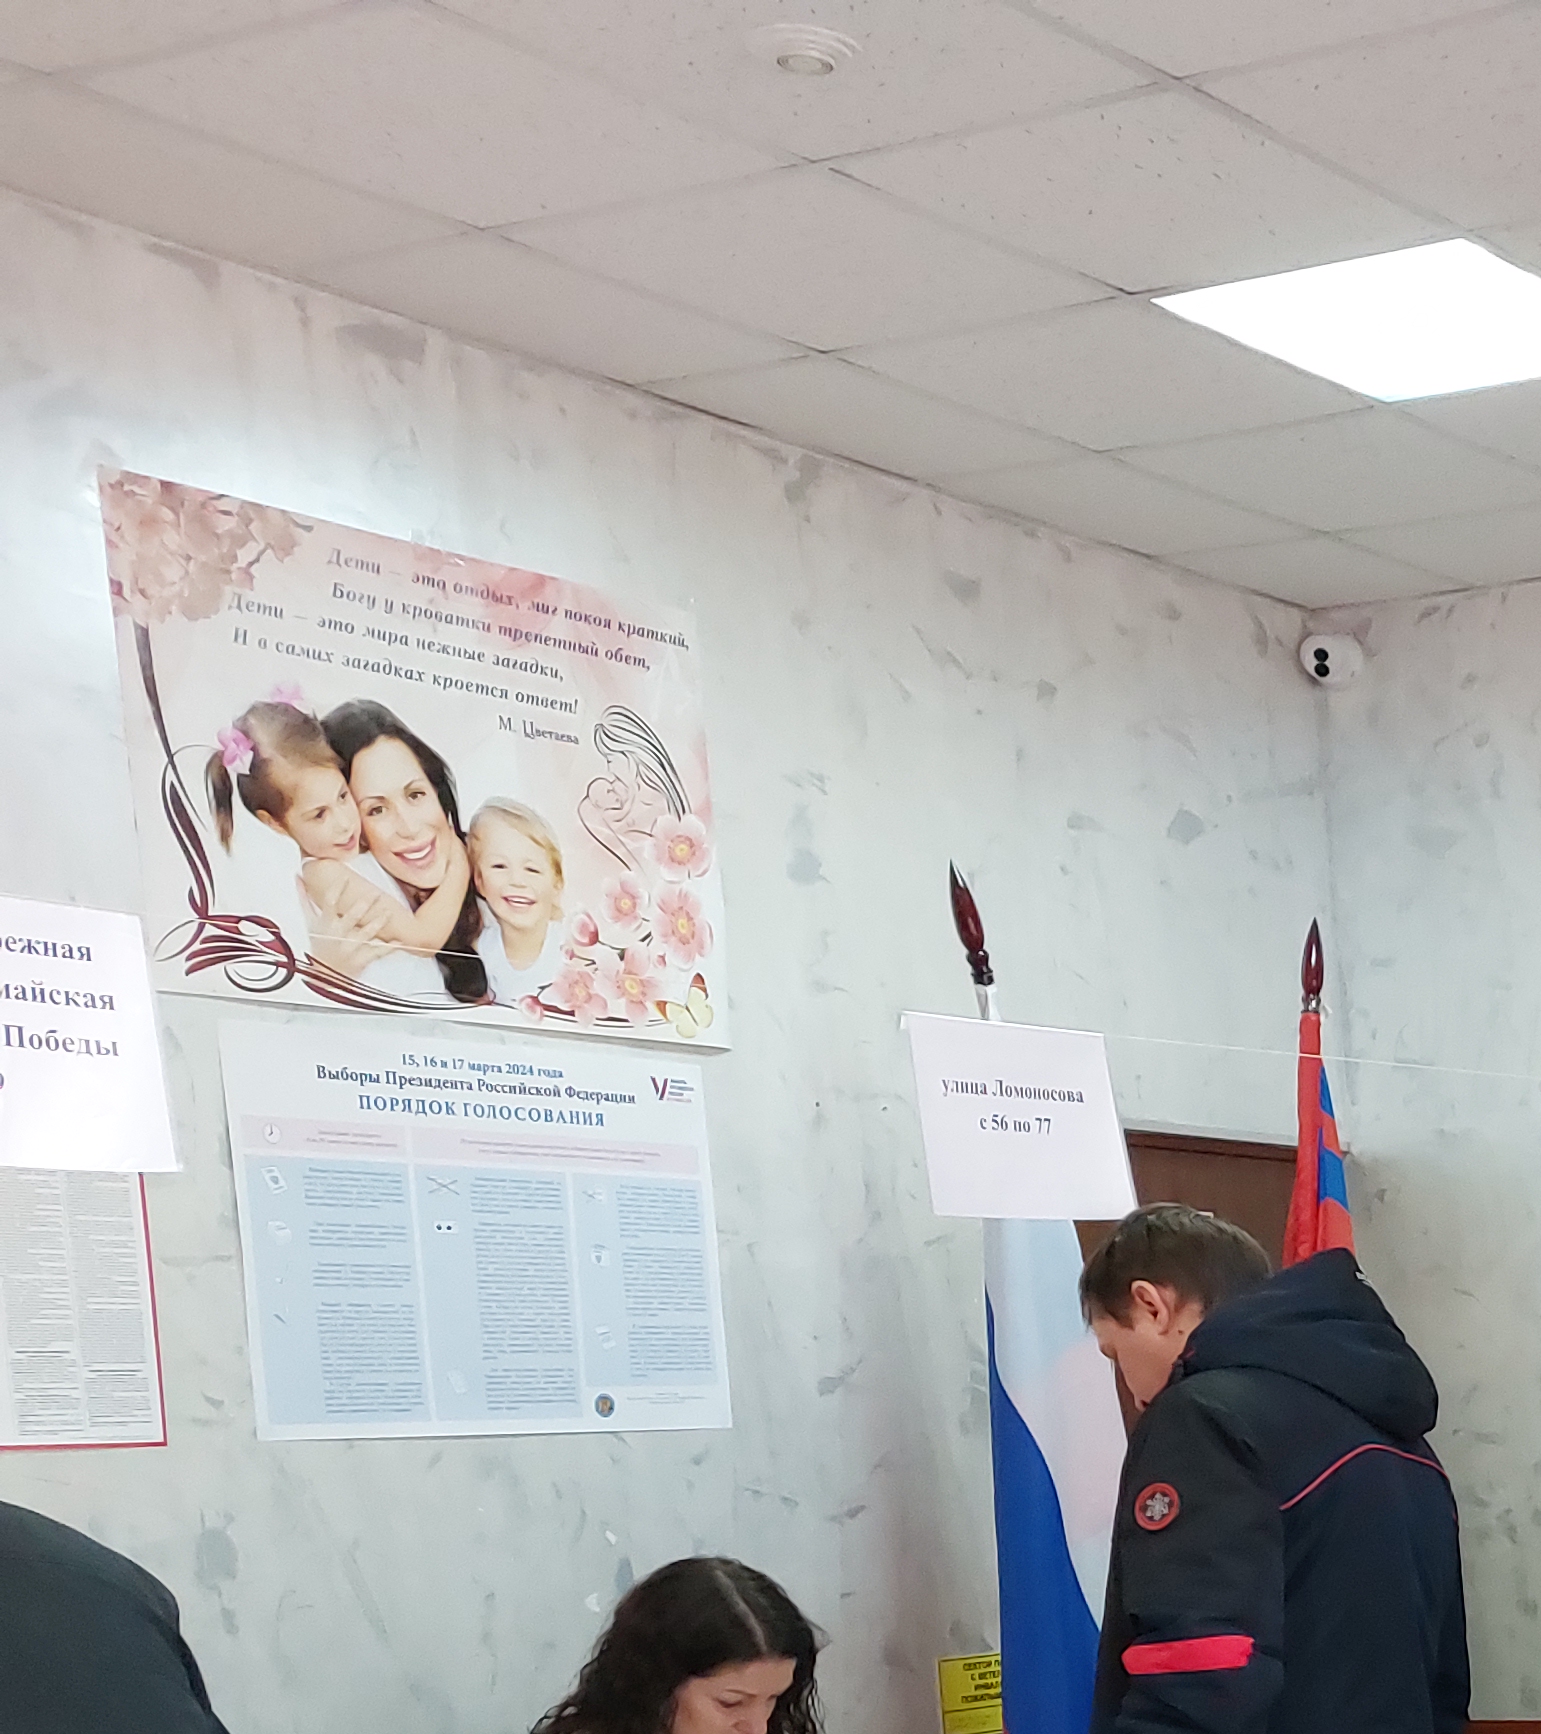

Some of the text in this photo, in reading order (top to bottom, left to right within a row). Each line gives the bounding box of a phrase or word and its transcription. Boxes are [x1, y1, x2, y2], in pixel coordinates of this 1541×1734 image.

[326, 547, 381, 576] Дети
[453, 581, 520, 610] отдых,
[527, 599, 558, 616] миг
[564, 607, 612, 631] покоя
[617, 620, 689, 651] краткий,
[228, 592, 284, 620] Дети
[317, 616, 355, 634] это
[362, 625, 409, 647] мира
[416, 637, 485, 663] нежные
[492, 652, 564, 682] загадки,
[332, 581, 651, 672] Богу у кроватки трепетный обет,
[233, 626, 248, 646] И
[276, 641, 334, 664] самих
[341, 655, 426, 683] загадках
[432, 673, 509, 700] кроется
[515, 690, 578, 715] ответ!
[498, 715, 580, 745] М. Цветаева
[0, 935, 93, 962] ежная
[2, 1024, 120, 1057] Победы
[402, 1053, 564, 1079] 15, 16 и 17 марта 2024 года
[316, 1064, 637, 1106] Выборы Президента Российской Федерации
[942, 1078, 1085, 1104] улица Ломоносова
[358, 1094, 605, 1128] ПОРЯДОК ГОЛОСОВАНИЯ
[980, 1114, 1051, 1136] с 56 по 77
